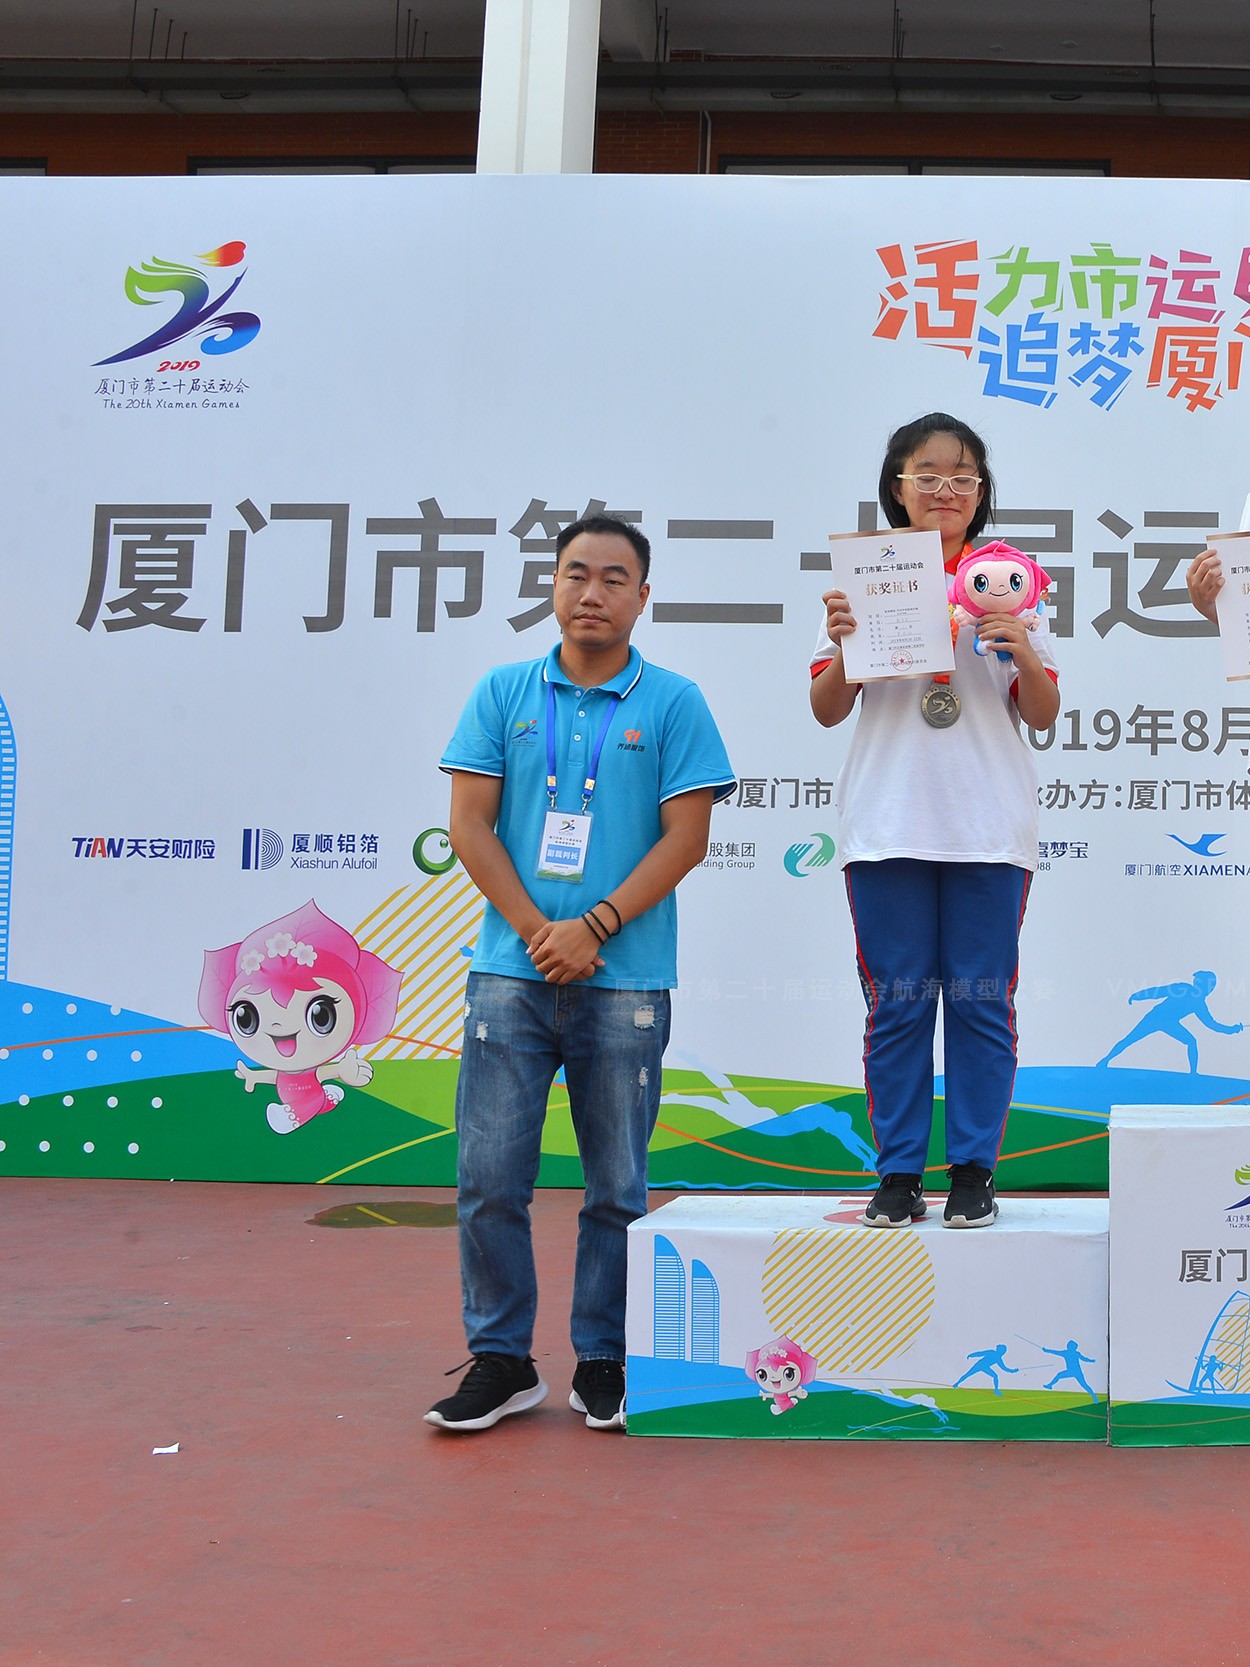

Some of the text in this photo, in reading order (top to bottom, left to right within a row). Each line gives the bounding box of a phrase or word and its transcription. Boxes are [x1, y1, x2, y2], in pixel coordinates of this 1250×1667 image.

[872, 239, 1221, 341] 活力市运
[156, 360, 201, 372] 2019
[95, 377, 250, 396] 厦门市第二十届运动会
[103, 399, 240, 409] The 20th Xiamen Games
[854, 562, 924, 575] 厦门市第二十届运动会
[866, 580, 918, 596] 获奖证书
[291, 833, 380, 854] 厦顺铝箔
[290, 856, 378, 869] Xiashun Alufoil
[726, 859, 755, 870] Group
[1124, 864, 1182, 877] 厦门航空
